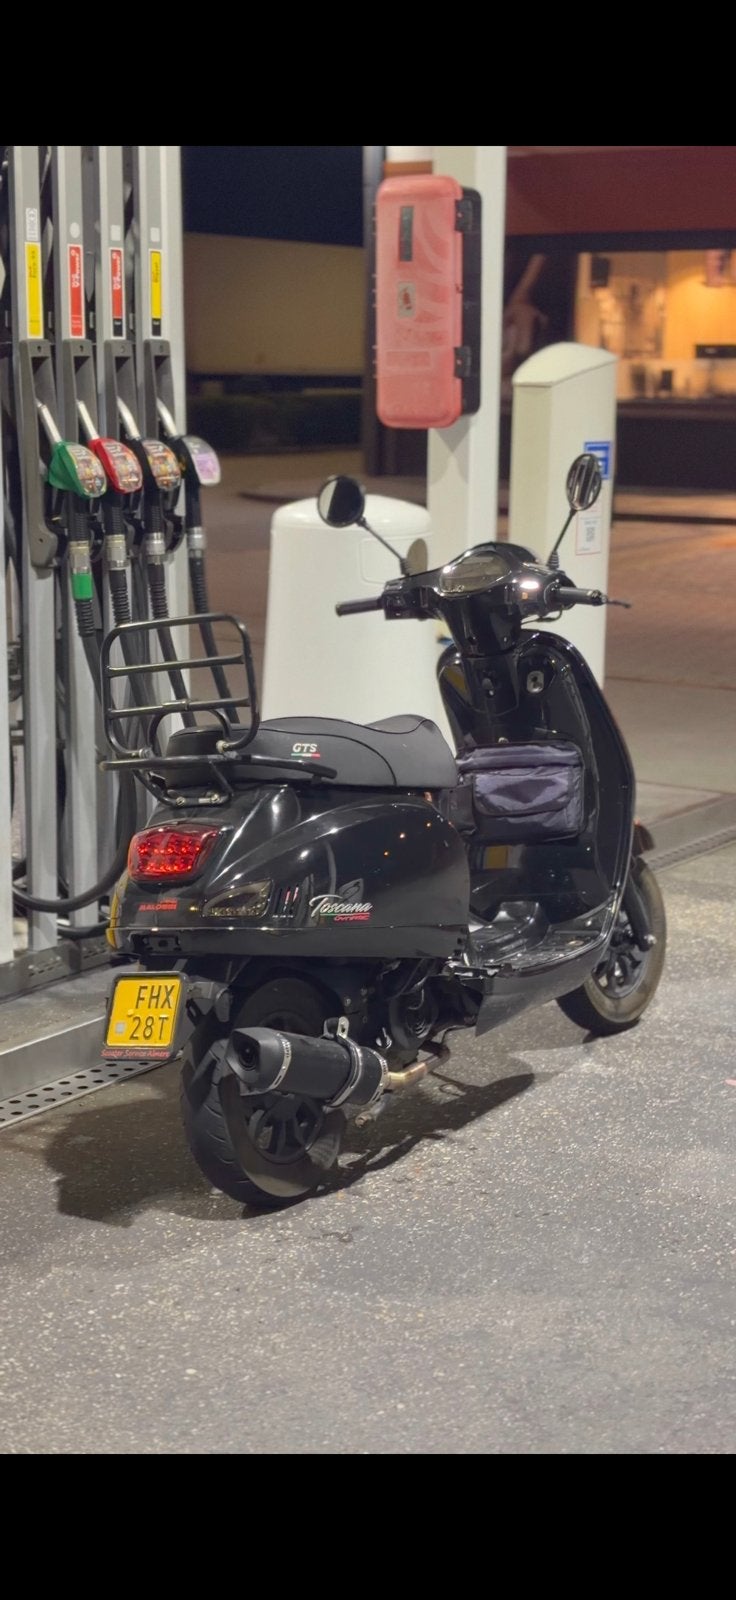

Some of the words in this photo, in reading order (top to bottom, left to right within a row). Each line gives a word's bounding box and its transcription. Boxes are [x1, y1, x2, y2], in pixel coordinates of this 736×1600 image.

[293, 743, 317, 753] GTS
[309, 894, 373, 918] Toscana
[136, 985, 174, 1009] FHX
[130, 1016, 168, 1041] 28T
